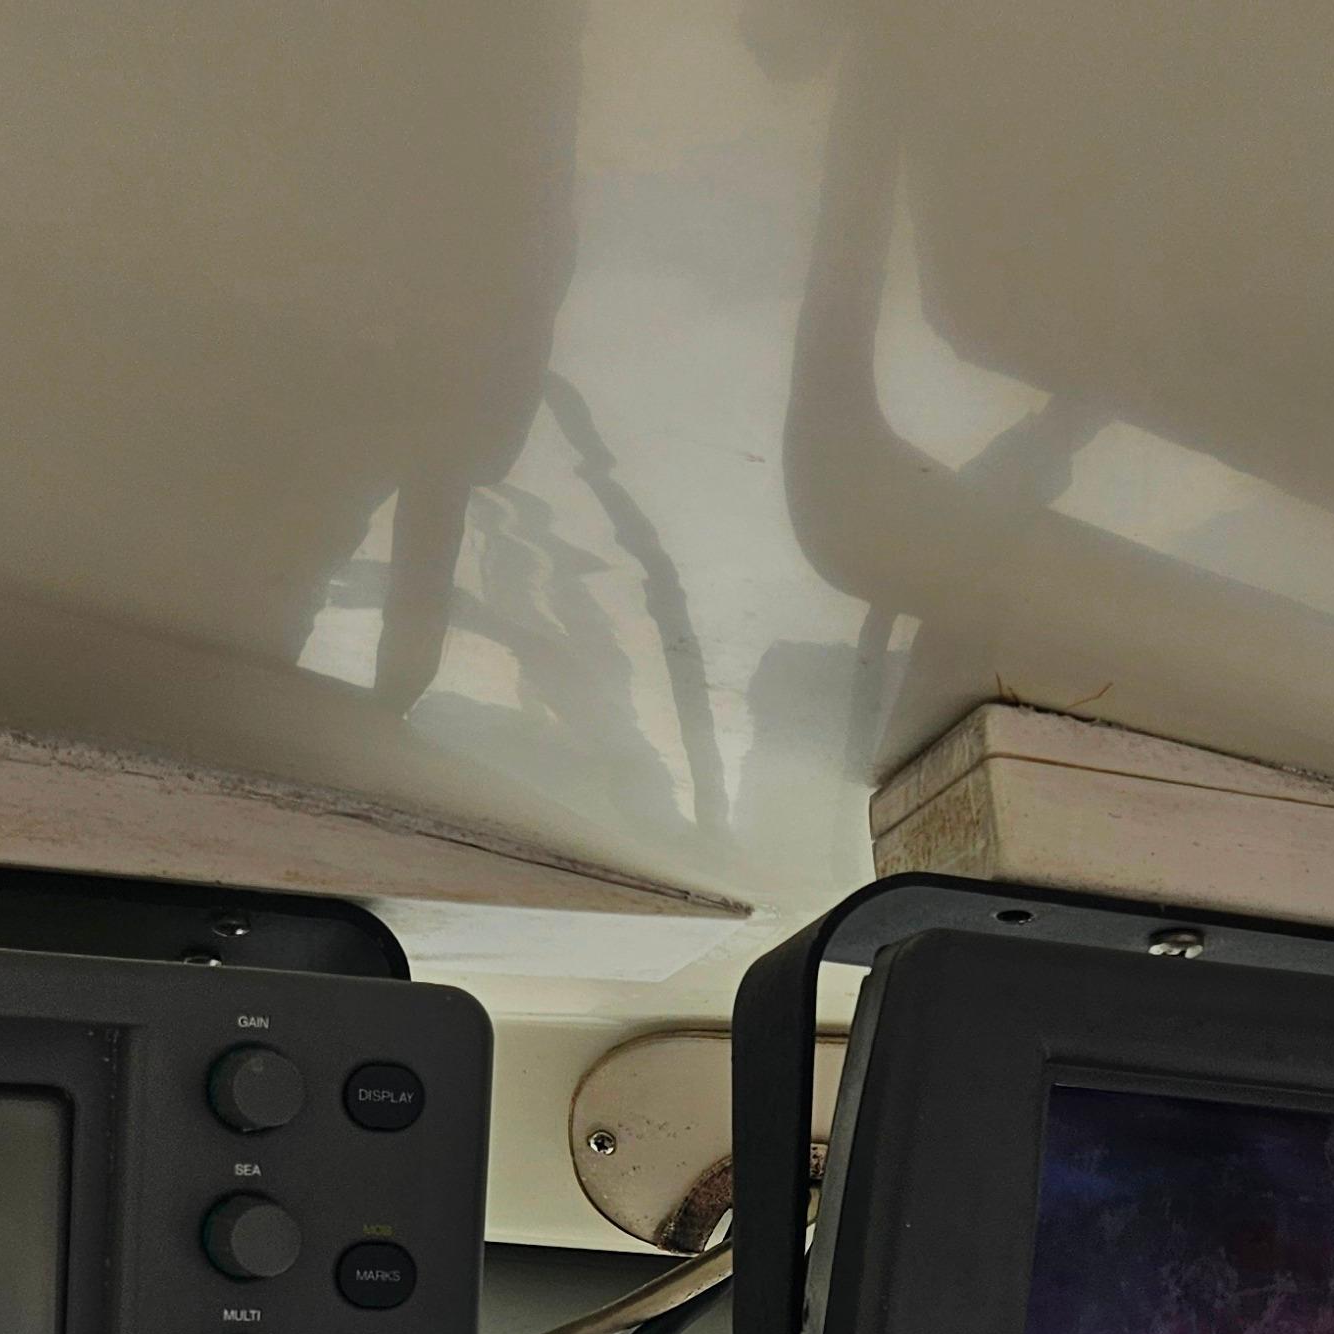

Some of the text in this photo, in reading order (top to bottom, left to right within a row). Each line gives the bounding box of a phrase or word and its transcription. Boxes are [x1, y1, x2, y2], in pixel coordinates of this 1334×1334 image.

[237, 1015, 269, 1029] GAIN
[358, 1088, 414, 1104] DISPLAY
[234, 1163, 262, 1177] SEA
[355, 1269, 402, 1282] MARKS
[223, 1308, 261, 1322] MULTI
